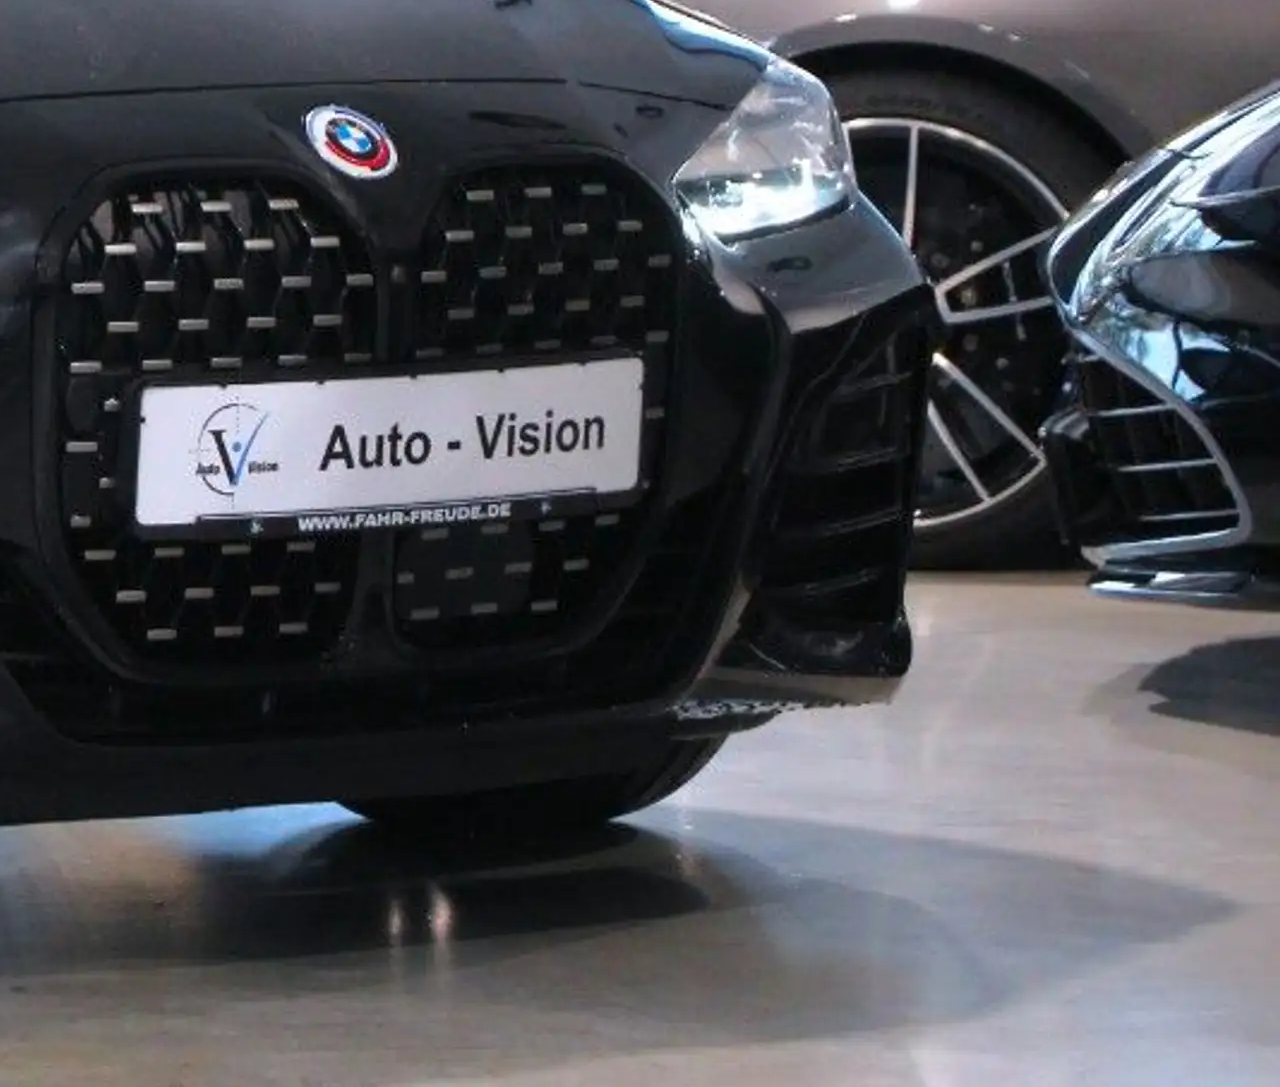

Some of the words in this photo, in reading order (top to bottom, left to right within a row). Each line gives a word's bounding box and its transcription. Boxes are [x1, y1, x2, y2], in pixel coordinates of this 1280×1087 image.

[319, 422, 432, 471] Auto
[447, 440, 461, 451] -
[476, 410, 605, 460] Vision
[297, 503, 511, 531] WWW.FAHR-FREUDE.DE
